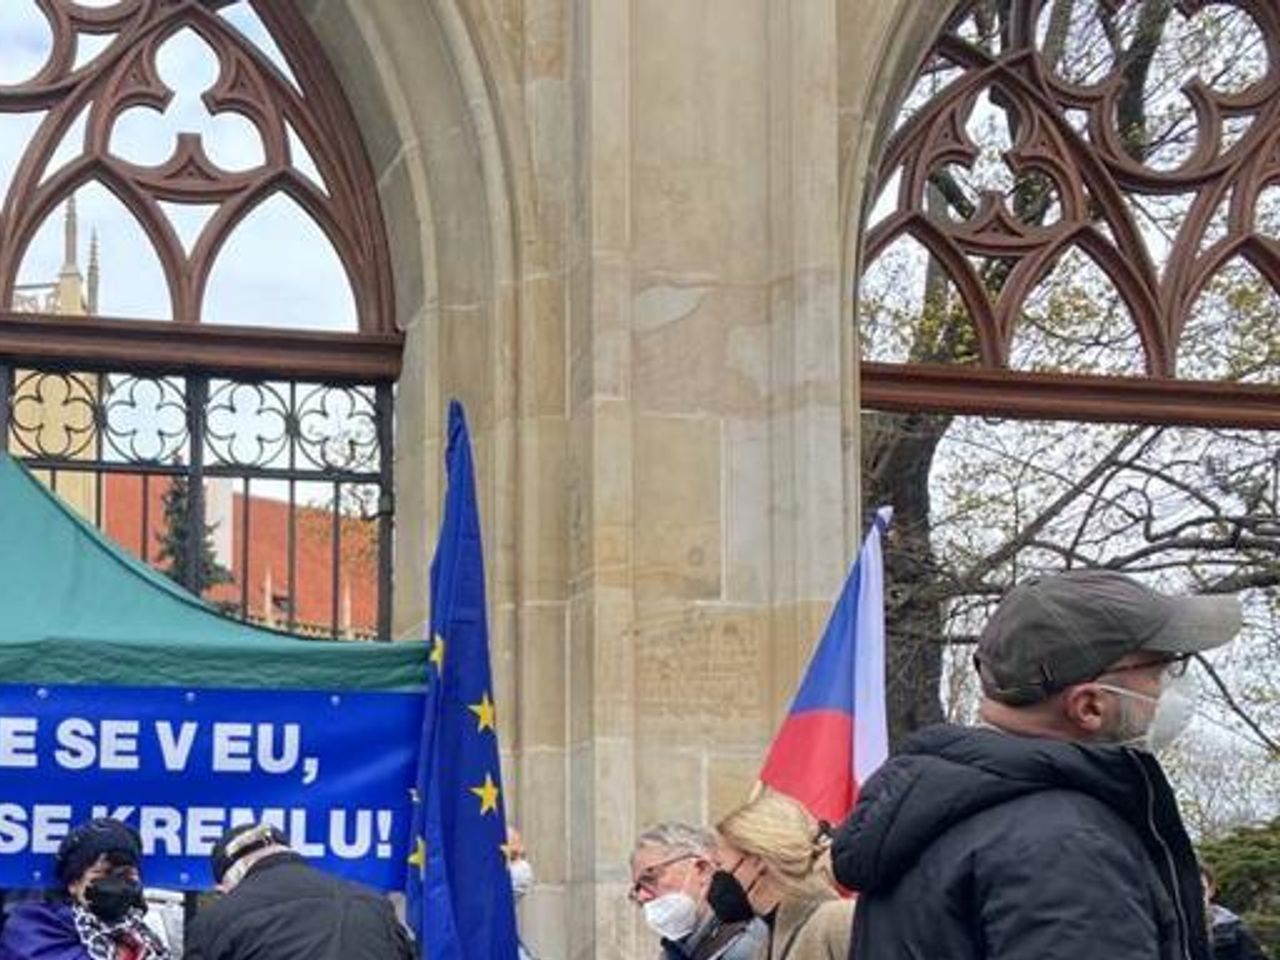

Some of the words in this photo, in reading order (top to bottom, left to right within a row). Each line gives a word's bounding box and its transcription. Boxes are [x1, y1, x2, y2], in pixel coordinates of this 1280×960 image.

[55, 717, 139, 769] SE
[155, 720, 198, 771] V
[213, 722, 319, 784] EU,
